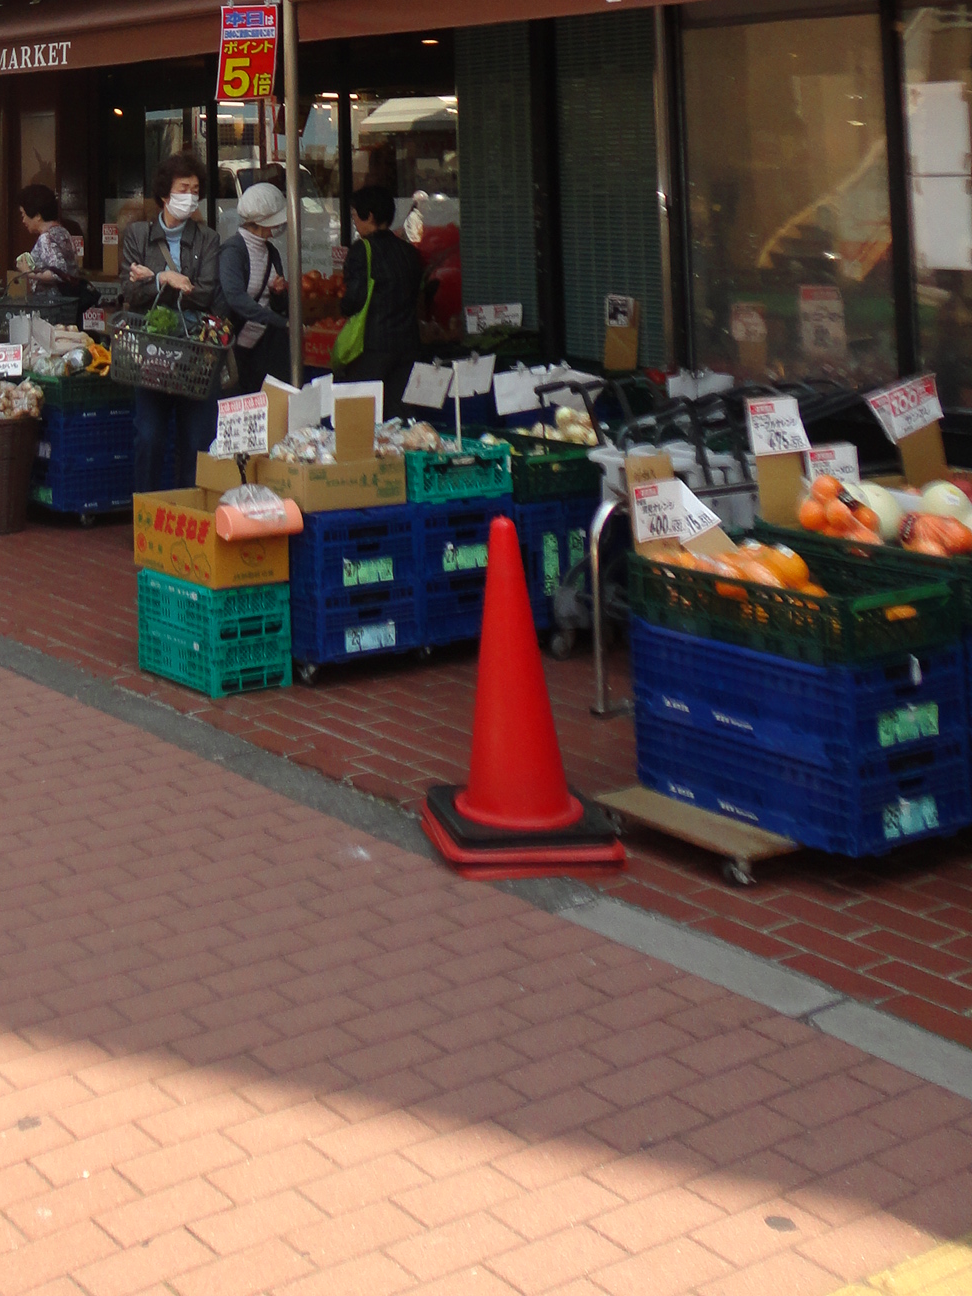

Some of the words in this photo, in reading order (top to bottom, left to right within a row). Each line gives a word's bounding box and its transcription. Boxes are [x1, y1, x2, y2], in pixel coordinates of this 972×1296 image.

[226, 10, 274, 26] 本日は
[224, 40, 273, 54] ポイント
[222, 57, 272, 98] 5倍
[890, 387, 919, 416] 100
